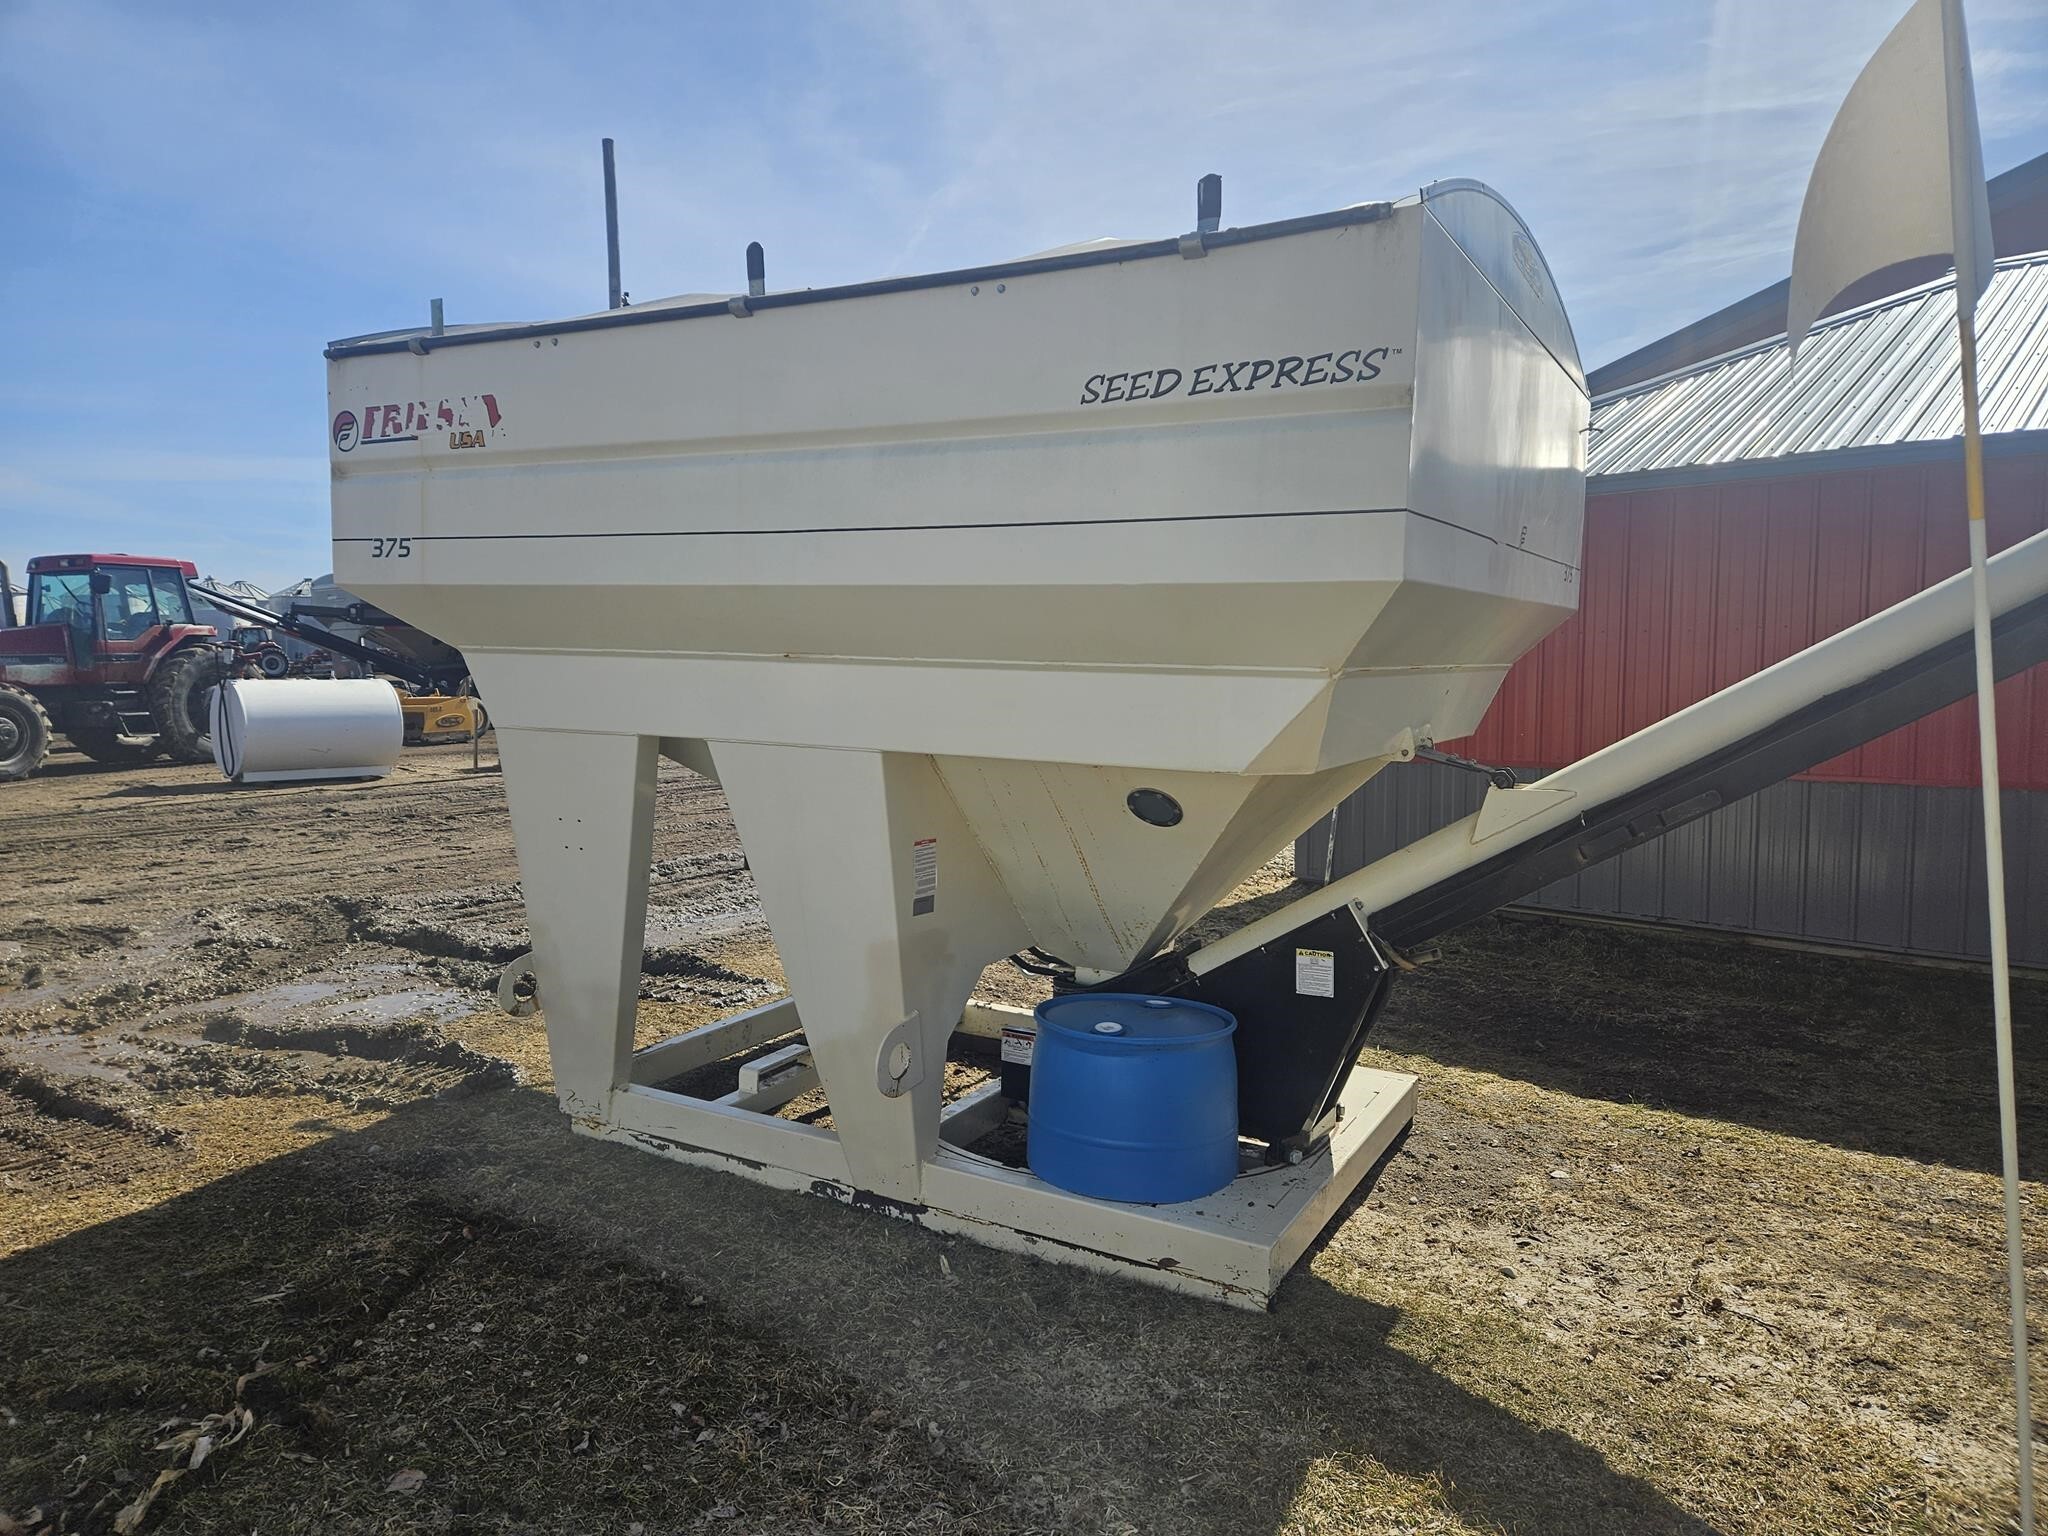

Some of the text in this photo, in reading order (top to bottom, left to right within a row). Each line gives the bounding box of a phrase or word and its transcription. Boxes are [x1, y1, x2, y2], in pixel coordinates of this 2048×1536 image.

[1080, 368, 1182, 405] SEED
[1187, 347, 1389, 396] EXPRESS
[449, 430, 485, 449] USA
[371, 537, 411, 558] 375
